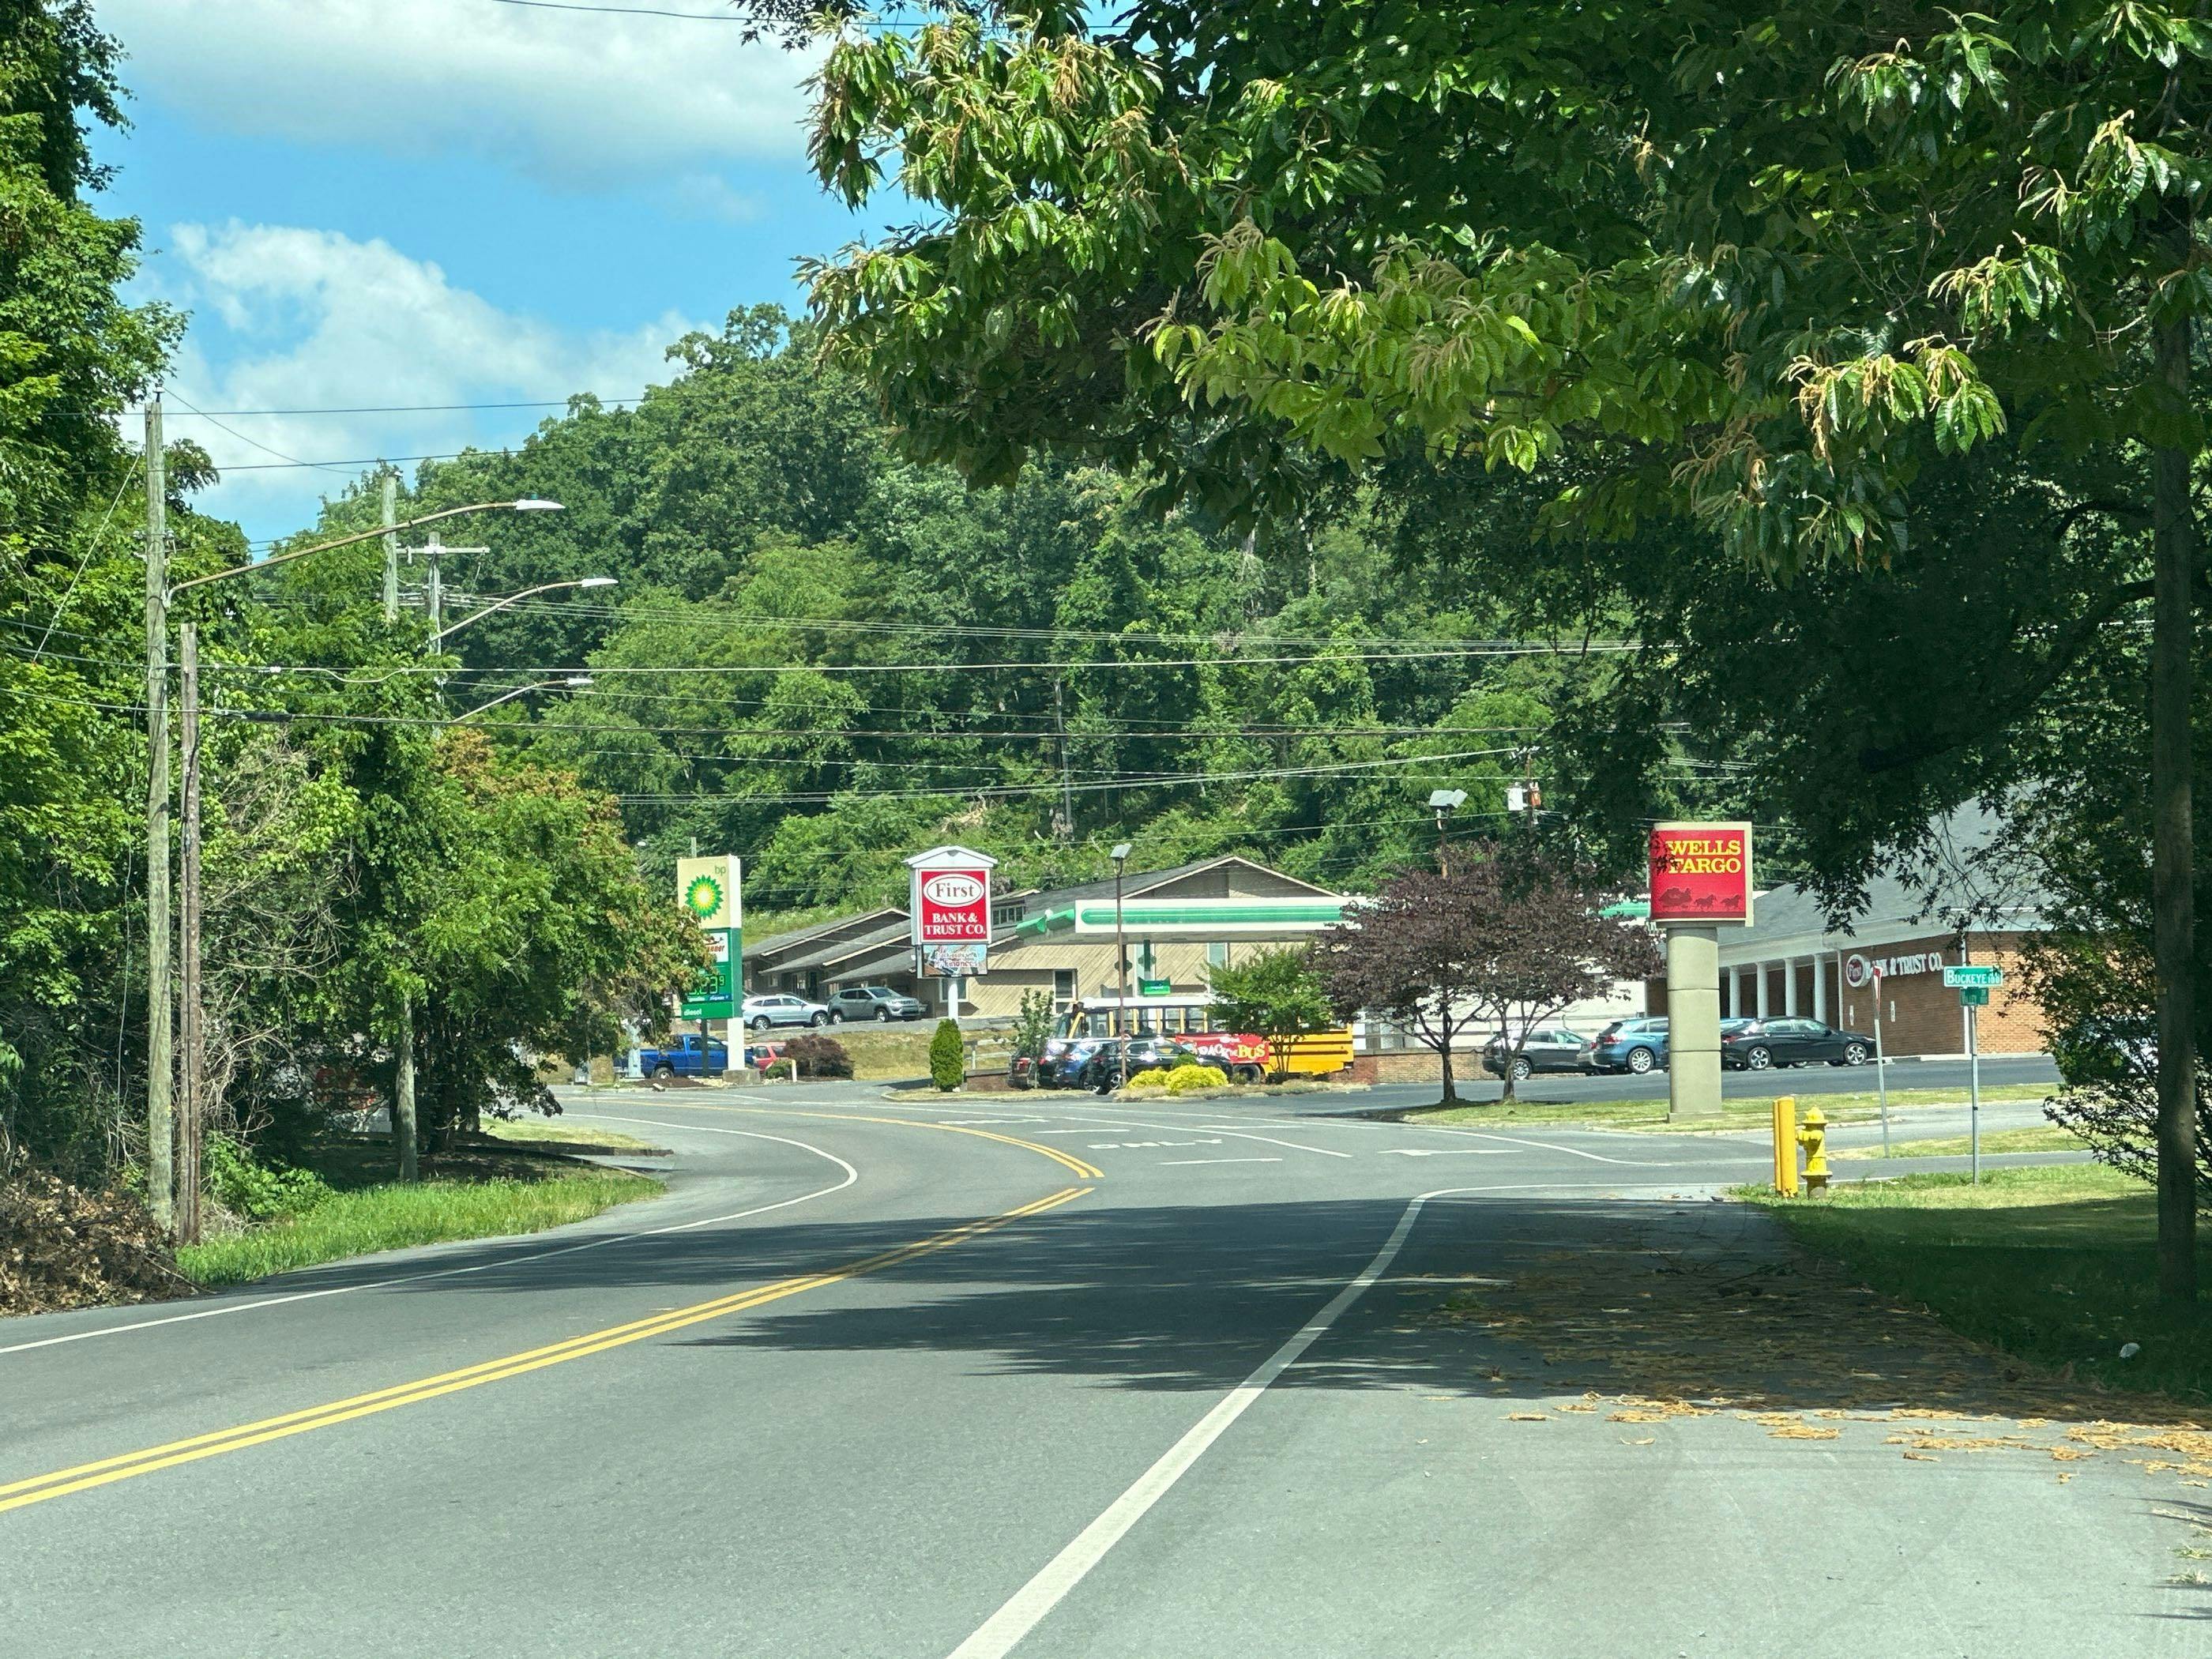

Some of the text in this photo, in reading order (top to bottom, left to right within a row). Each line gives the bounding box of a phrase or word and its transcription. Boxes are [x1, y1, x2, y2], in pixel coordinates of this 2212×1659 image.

[1665, 840, 1741, 856] WELLS
[714, 865, 726, 876] bp
[1668, 858, 1741, 874] FARGO
[935, 882, 974, 897] First
[932, 912, 978, 924] BANK &
[924, 924, 986, 935] TRUST CO.
[1897, 954, 1927, 976] TRUST
[1947, 969, 1987, 984] BUCKEYE
[1238, 1044, 1266, 1059] BUS
